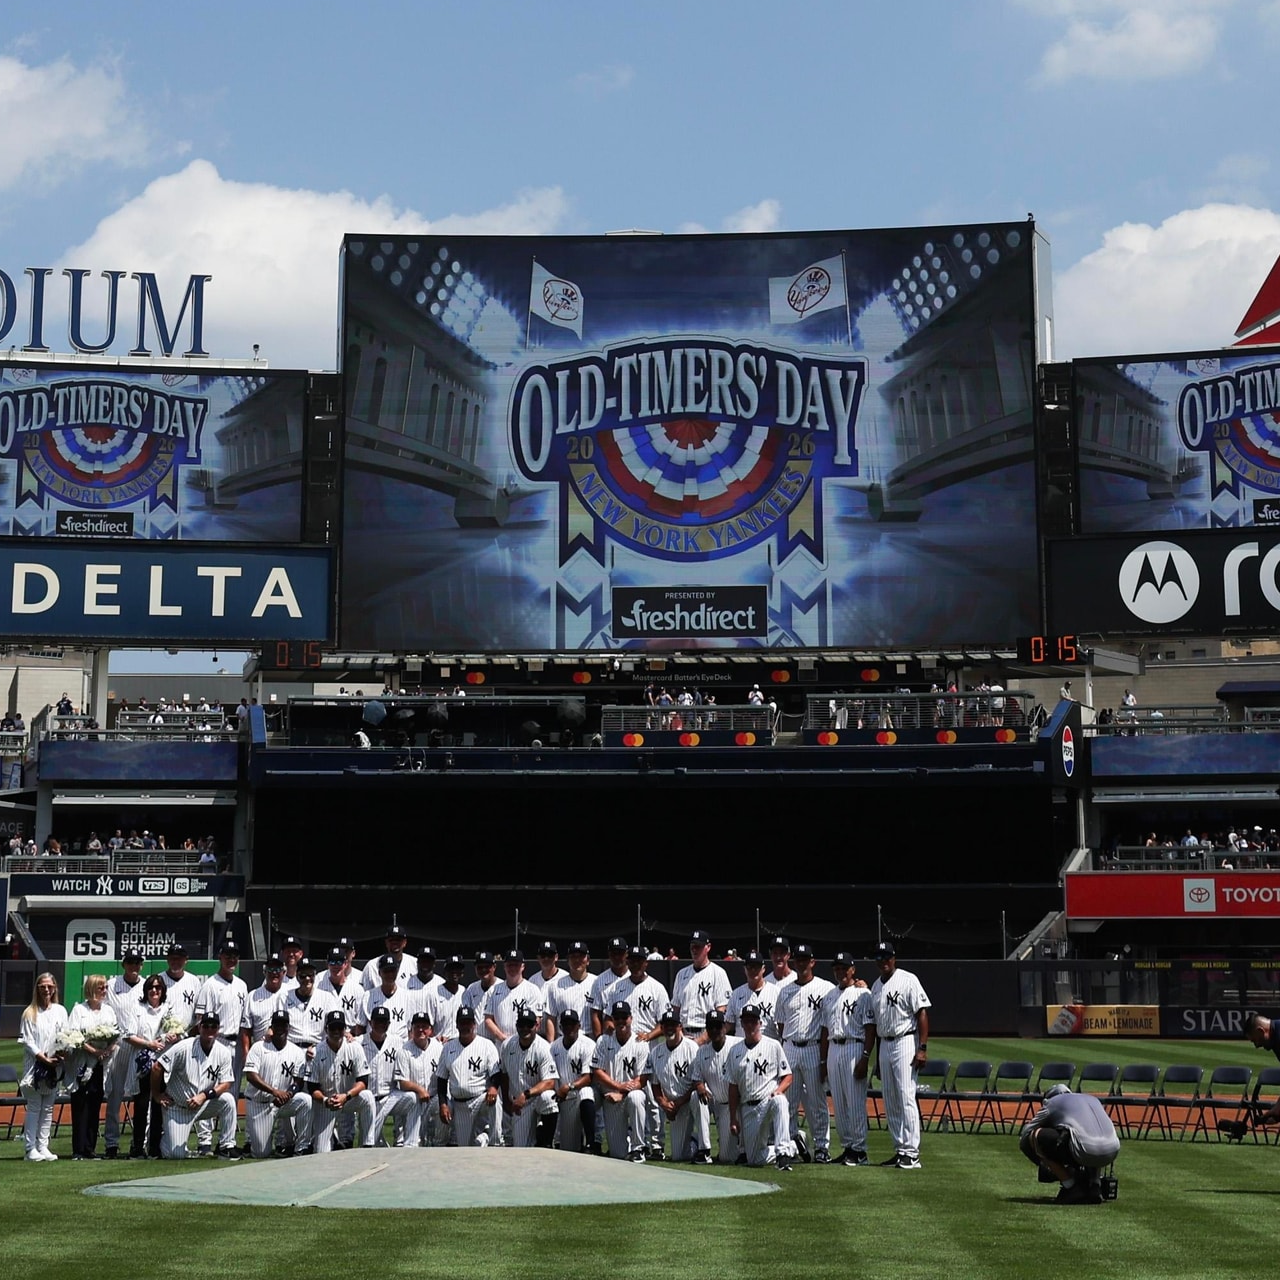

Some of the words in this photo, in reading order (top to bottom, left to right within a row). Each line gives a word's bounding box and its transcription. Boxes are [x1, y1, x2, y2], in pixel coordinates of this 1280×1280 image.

[519, 348, 768, 472] OLD-TIMERS'
[776, 360, 857, 466] DAY
[152, 396, 205, 458] DAY
[567, 436, 593, 460] 20
[789, 431, 816, 456] 26
[1223, 445, 1250, 477] NEW
[31, 454, 58, 488] NEW
[60, 481, 103, 503] YORK
[108, 458, 168, 502] YANKEES
[577, 470, 630, 533] NEW
[632, 517, 699, 553] YORK
[706, 468, 806, 550] YANKEES
[62, 517, 128, 534] freshdirect
[12, 562, 303, 619] DELTA
[665, 592, 700, 600] PRESENTED
[703, 591, 716, 600] BY
[624, 600, 756, 631] freshdirect
[276, 642, 320, 667] 0:15
[1031, 636, 1075, 662] 0:15
[632, 673, 672, 681] Mastercard
[674, 673, 700, 681] Batter's
[701, 673, 714, 682] Eye
[715, 673, 732, 681] Deck
[52, 880, 90, 891] WATCH
[118, 880, 133, 891] ON
[143, 881, 164, 890] YES
[177, 881, 188, 890] GS
[121, 933, 175, 944] GOTHAM
[122, 922, 147, 932] THE
[73, 932, 107, 955] GS
[1084, 1018, 1107, 1029] BEAM
[1113, 1018, 1153, 1029] LEMONADE
